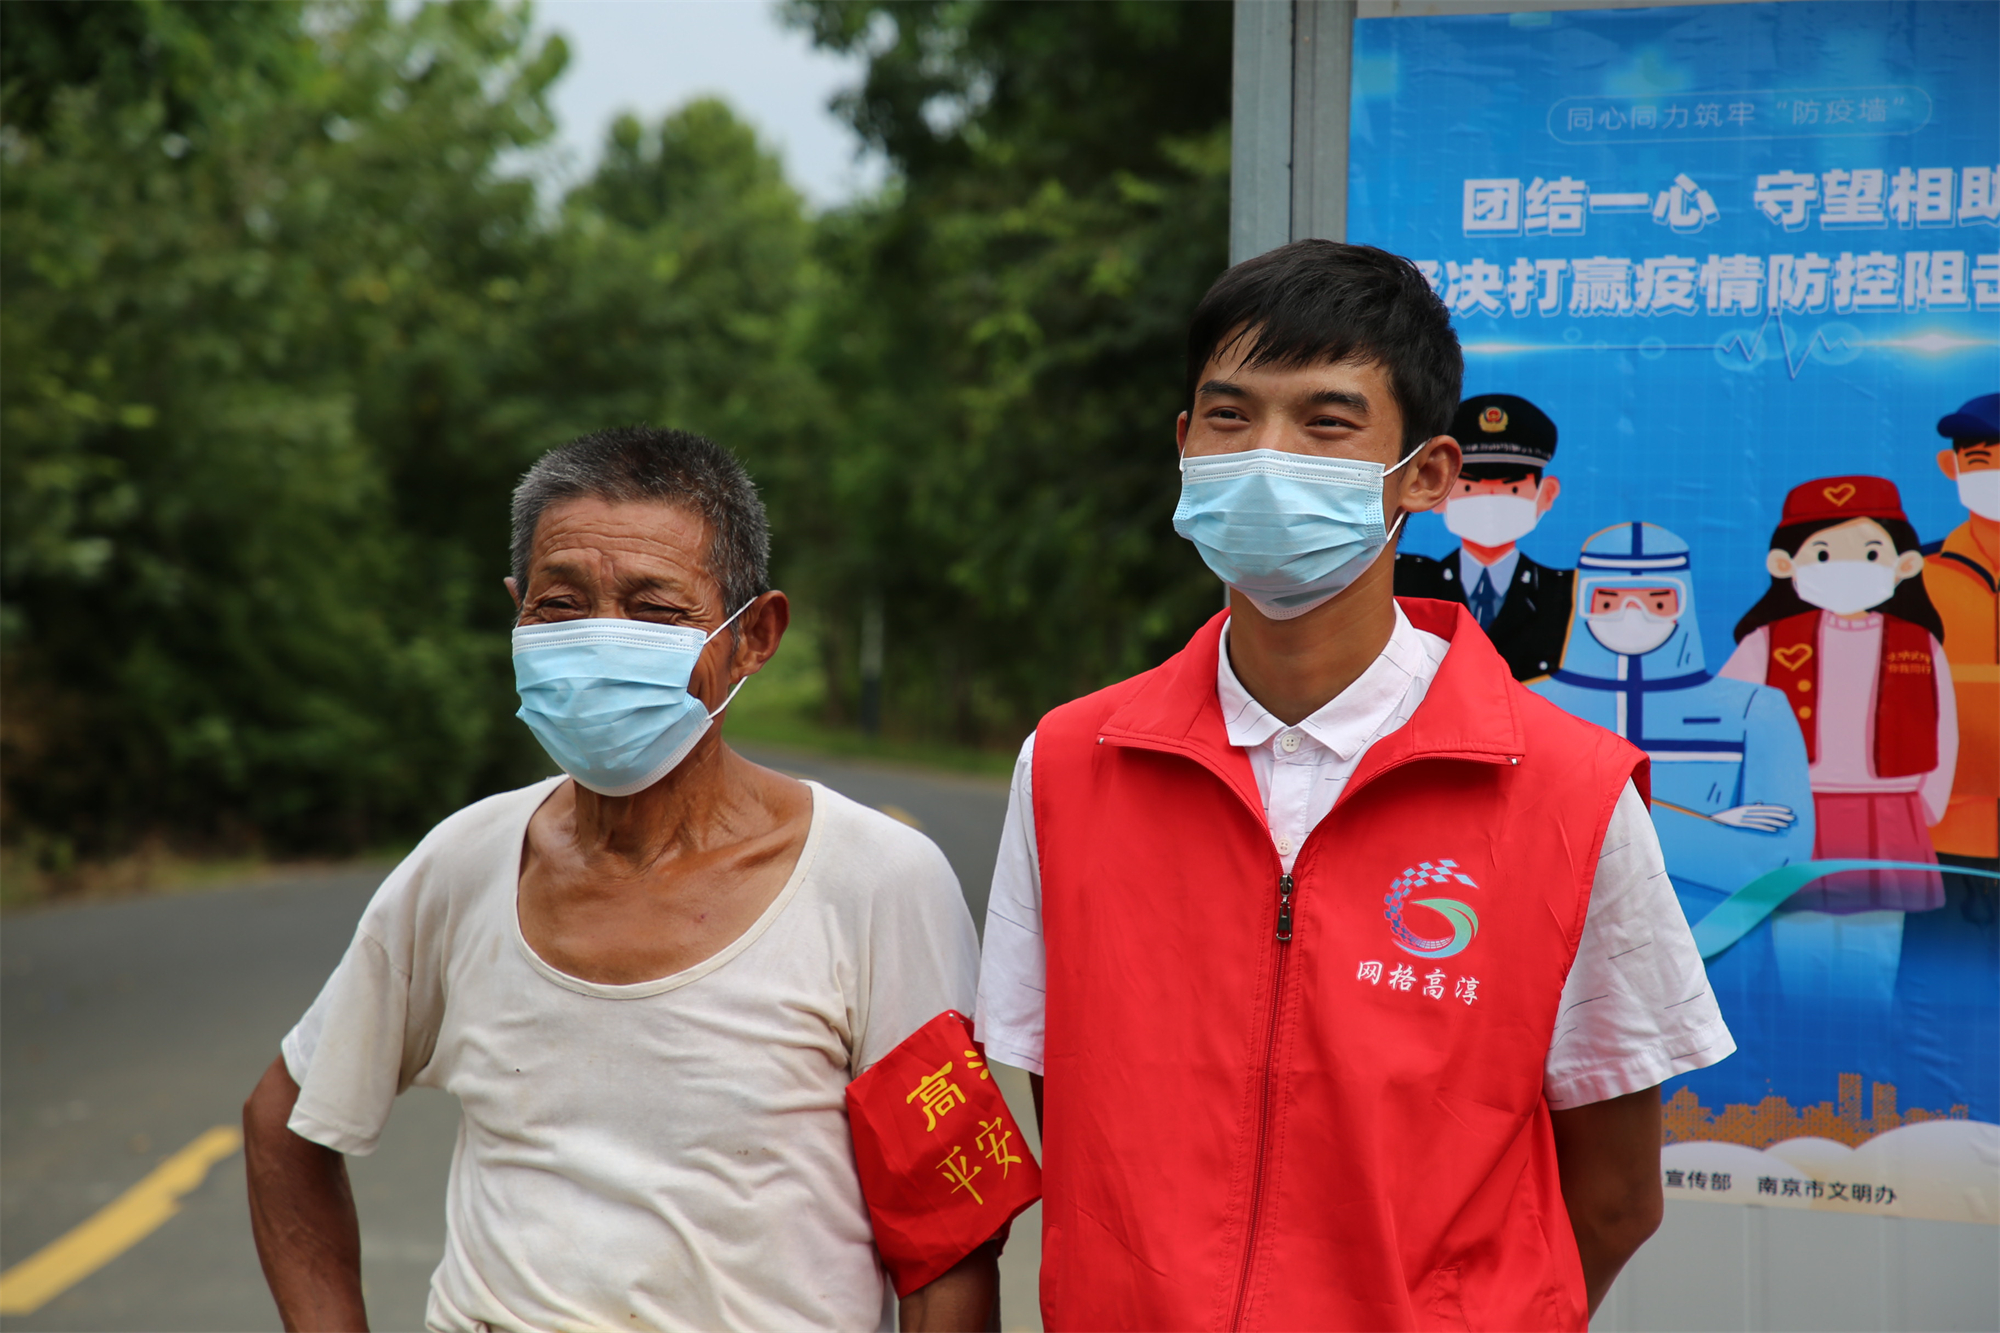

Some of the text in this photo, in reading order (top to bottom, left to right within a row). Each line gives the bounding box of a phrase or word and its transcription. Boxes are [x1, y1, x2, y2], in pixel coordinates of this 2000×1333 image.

[1567, 100, 1756, 132] 同心同力筑牢
[1462, 165, 2000, 237] 团结一心 守望相助
[1357, 960, 1480, 1006] 网格高淳
[936, 1116, 1023, 1205] 平安
[1665, 1168, 1898, 1205] 宣传部 南京市文明办
